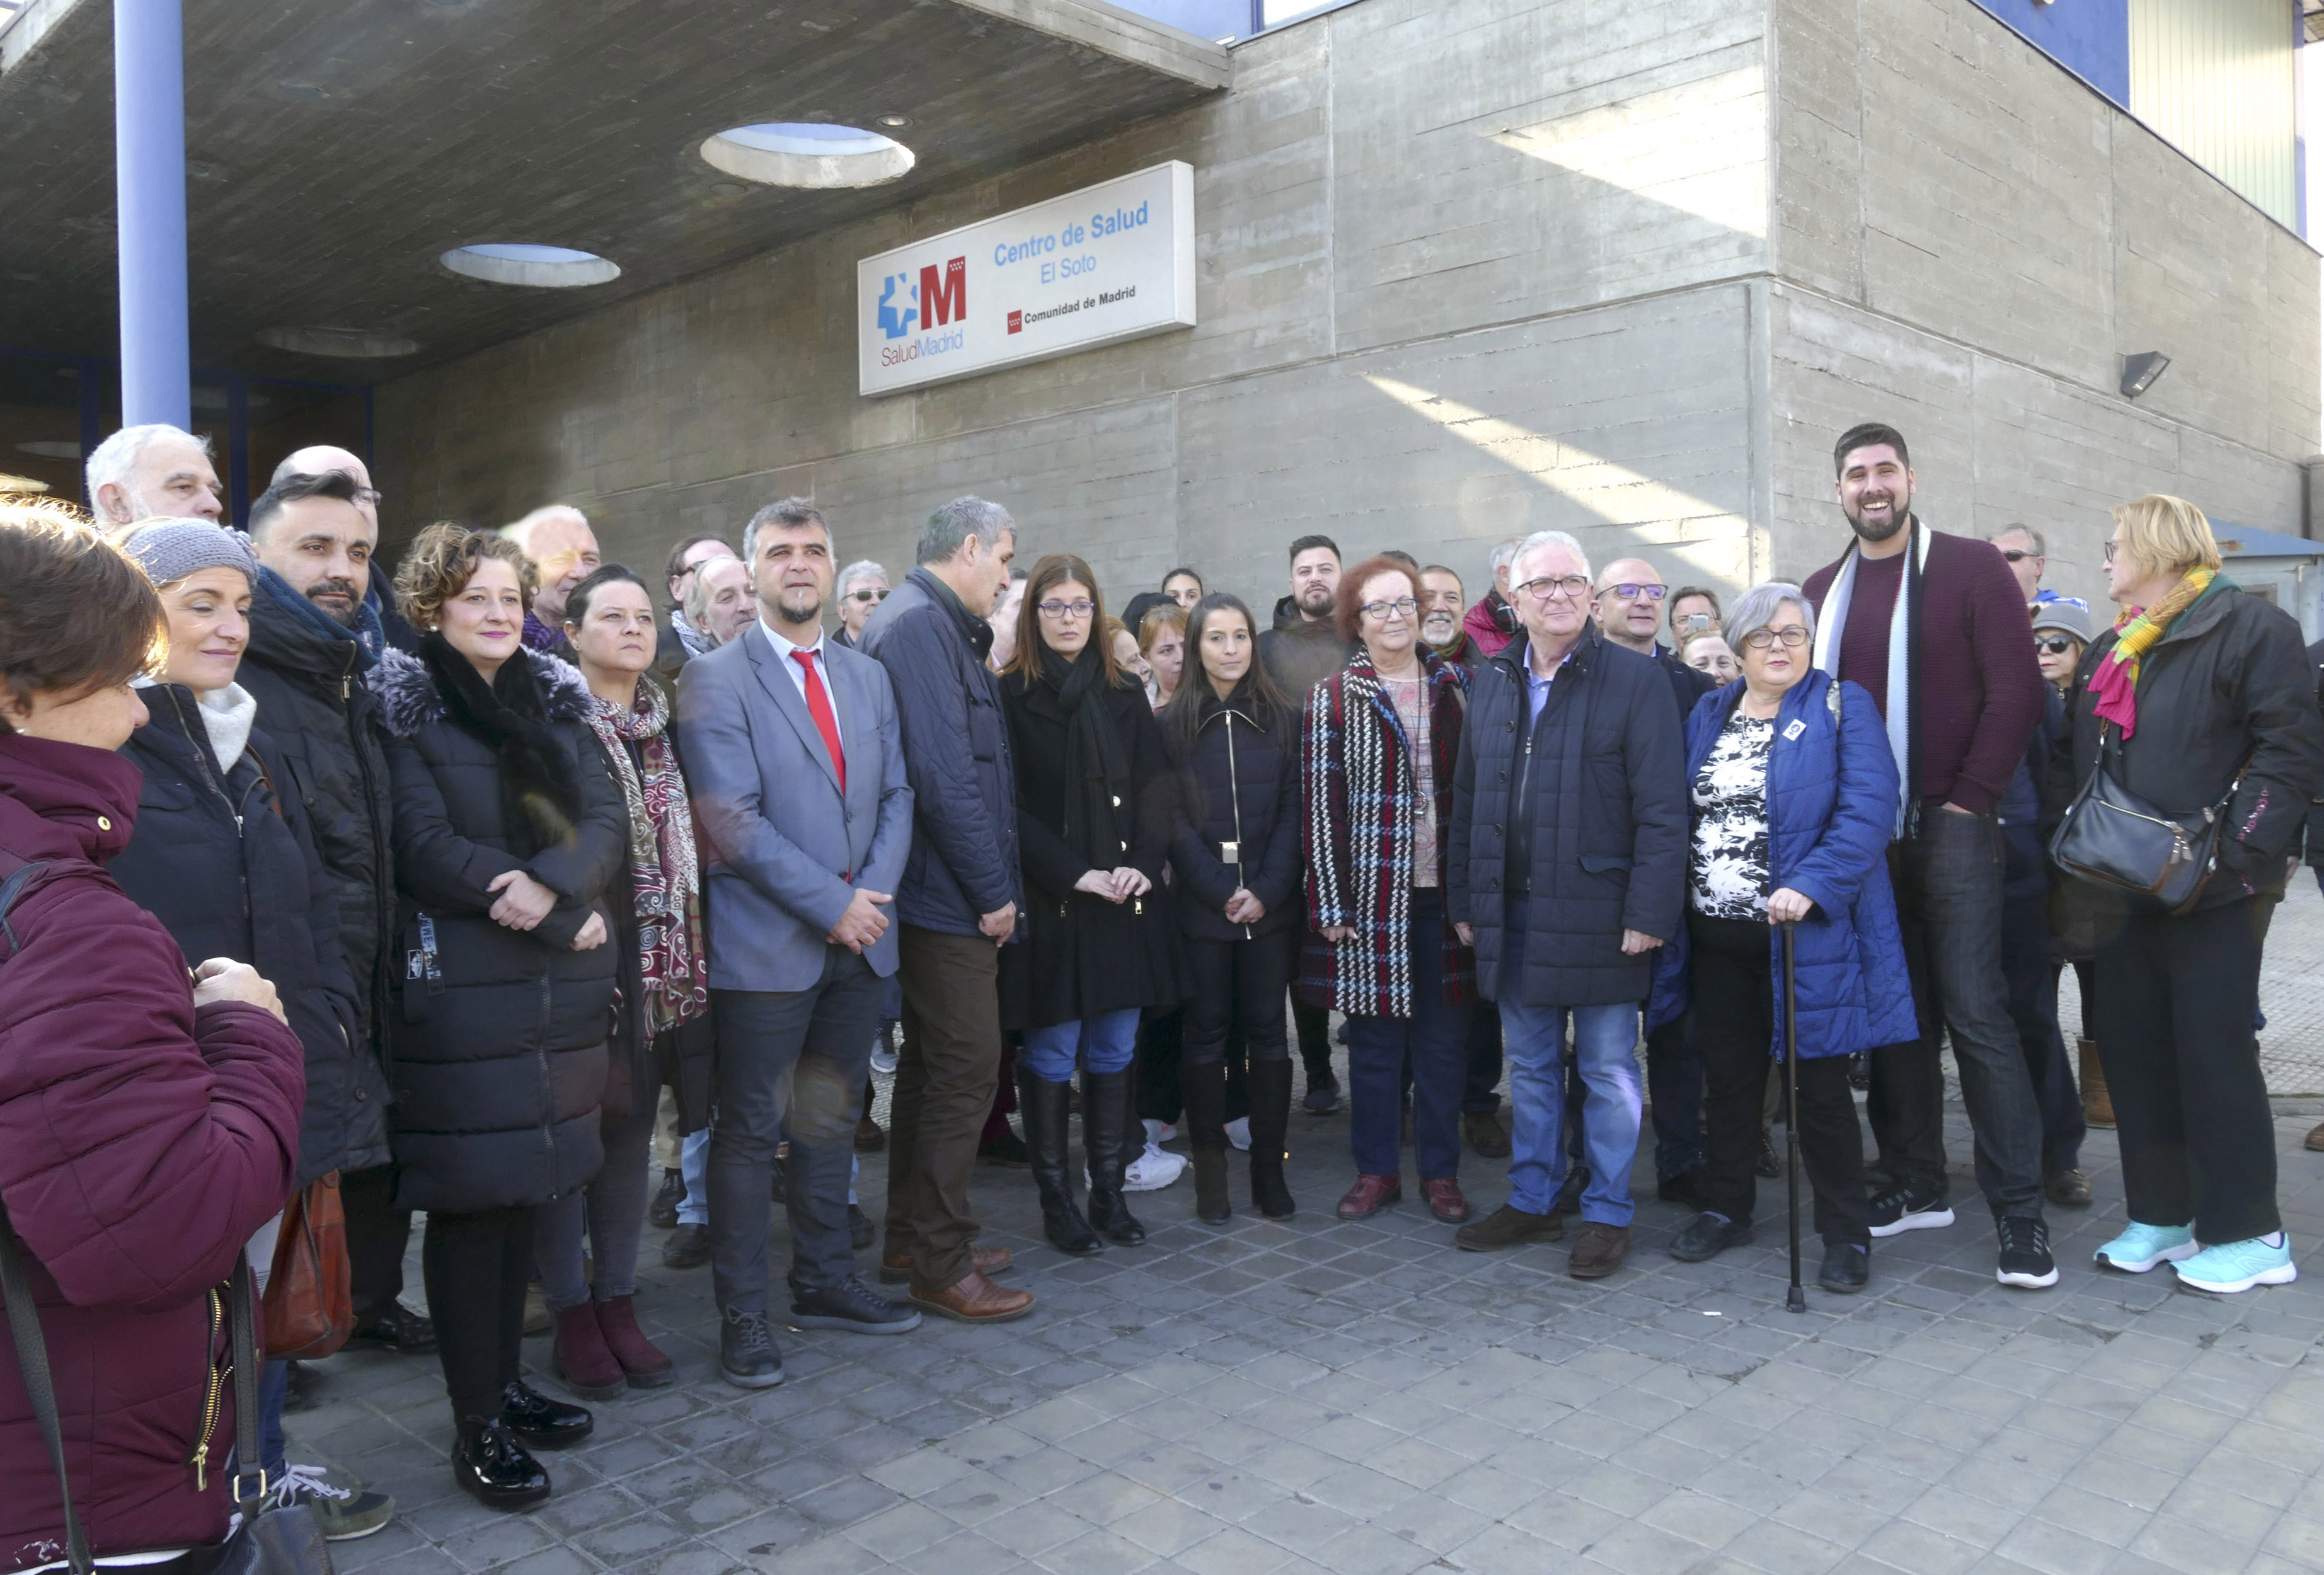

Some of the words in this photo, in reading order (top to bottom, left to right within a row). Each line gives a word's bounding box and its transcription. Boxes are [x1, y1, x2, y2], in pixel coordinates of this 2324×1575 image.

[994, 234, 1056, 266] Centro
[1062, 223, 1084, 247] de
[1091, 200, 1148, 239] Salud
[920, 256, 966, 330] M
[1041, 261, 1056, 284] El
[1061, 253, 1096, 278] Soto
[1025, 301, 1079, 324] Comunidad
[1083, 296, 1096, 309] de
[1099, 285, 1136, 306] Madrid
